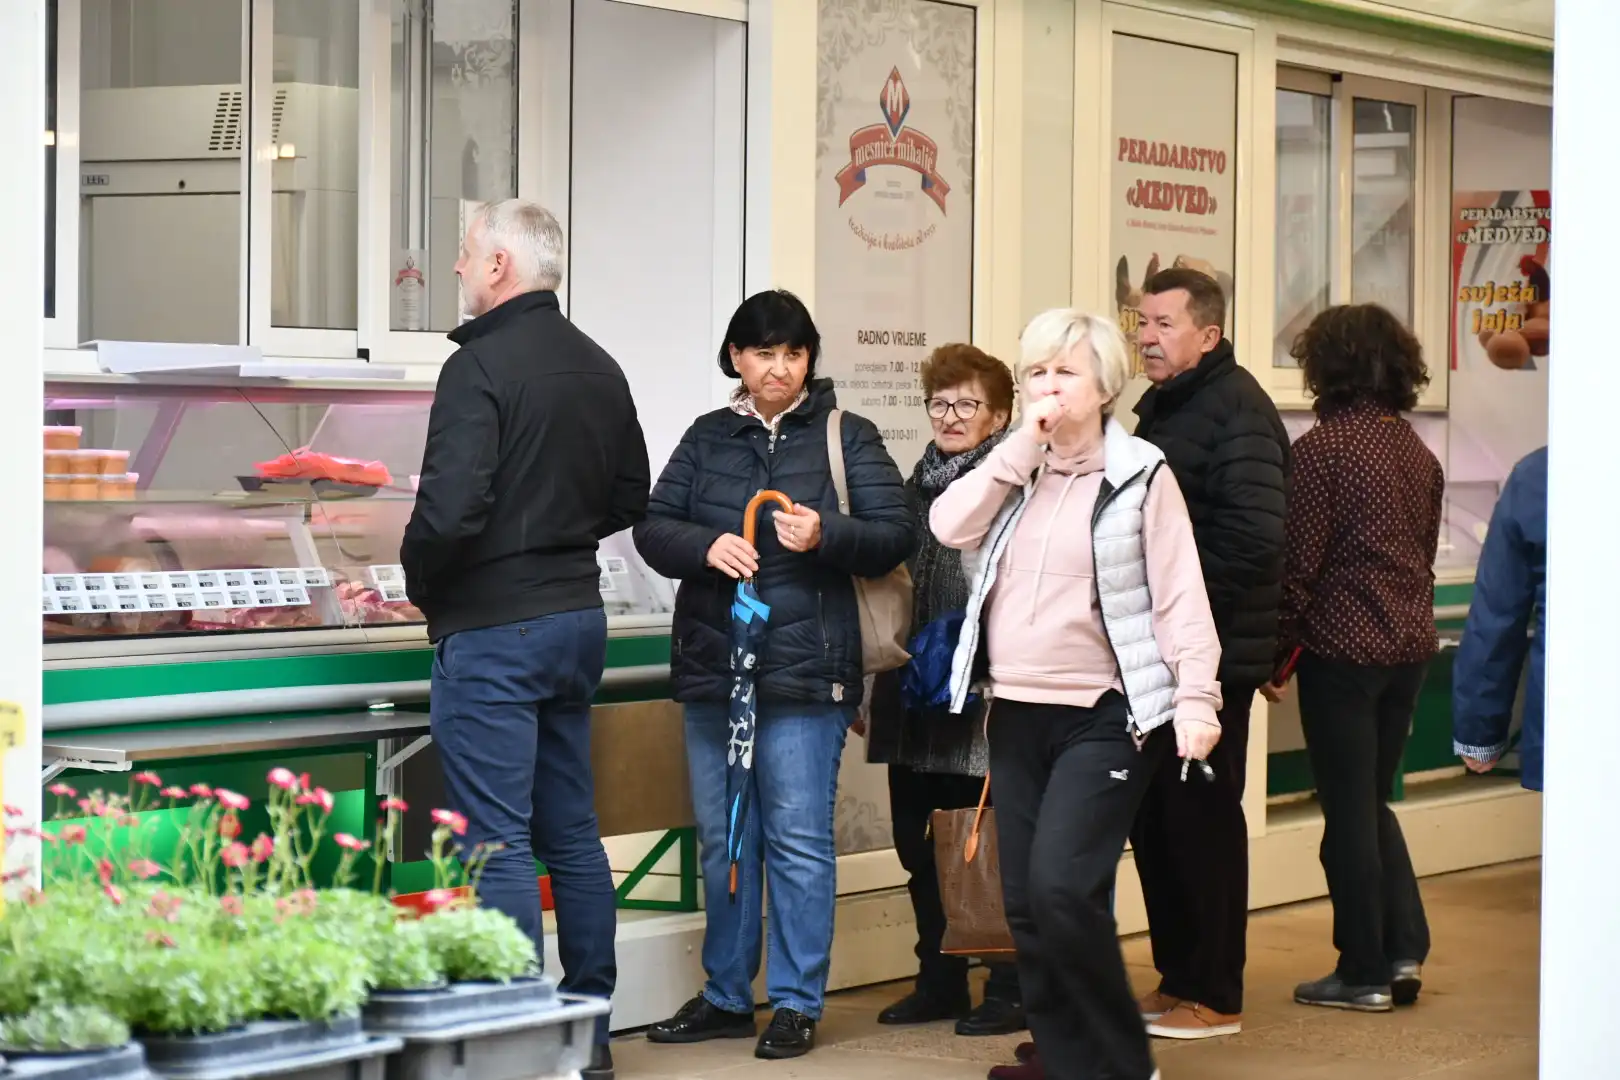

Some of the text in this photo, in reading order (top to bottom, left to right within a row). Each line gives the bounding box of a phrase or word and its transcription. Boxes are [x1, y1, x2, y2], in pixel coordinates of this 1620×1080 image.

[855, 133, 895, 168] mesnica
[1118, 137, 1226, 175] PERADARSTVO
[1459, 281, 1536, 307] svježa
[1472, 308, 1522, 335] jaja
[857, 330, 927, 347] RADNO VRIJEME
[889, 361, 904, 373] 7.00
[882, 395, 897, 407] 7.00
[904, 396, 922, 407] 13.00
